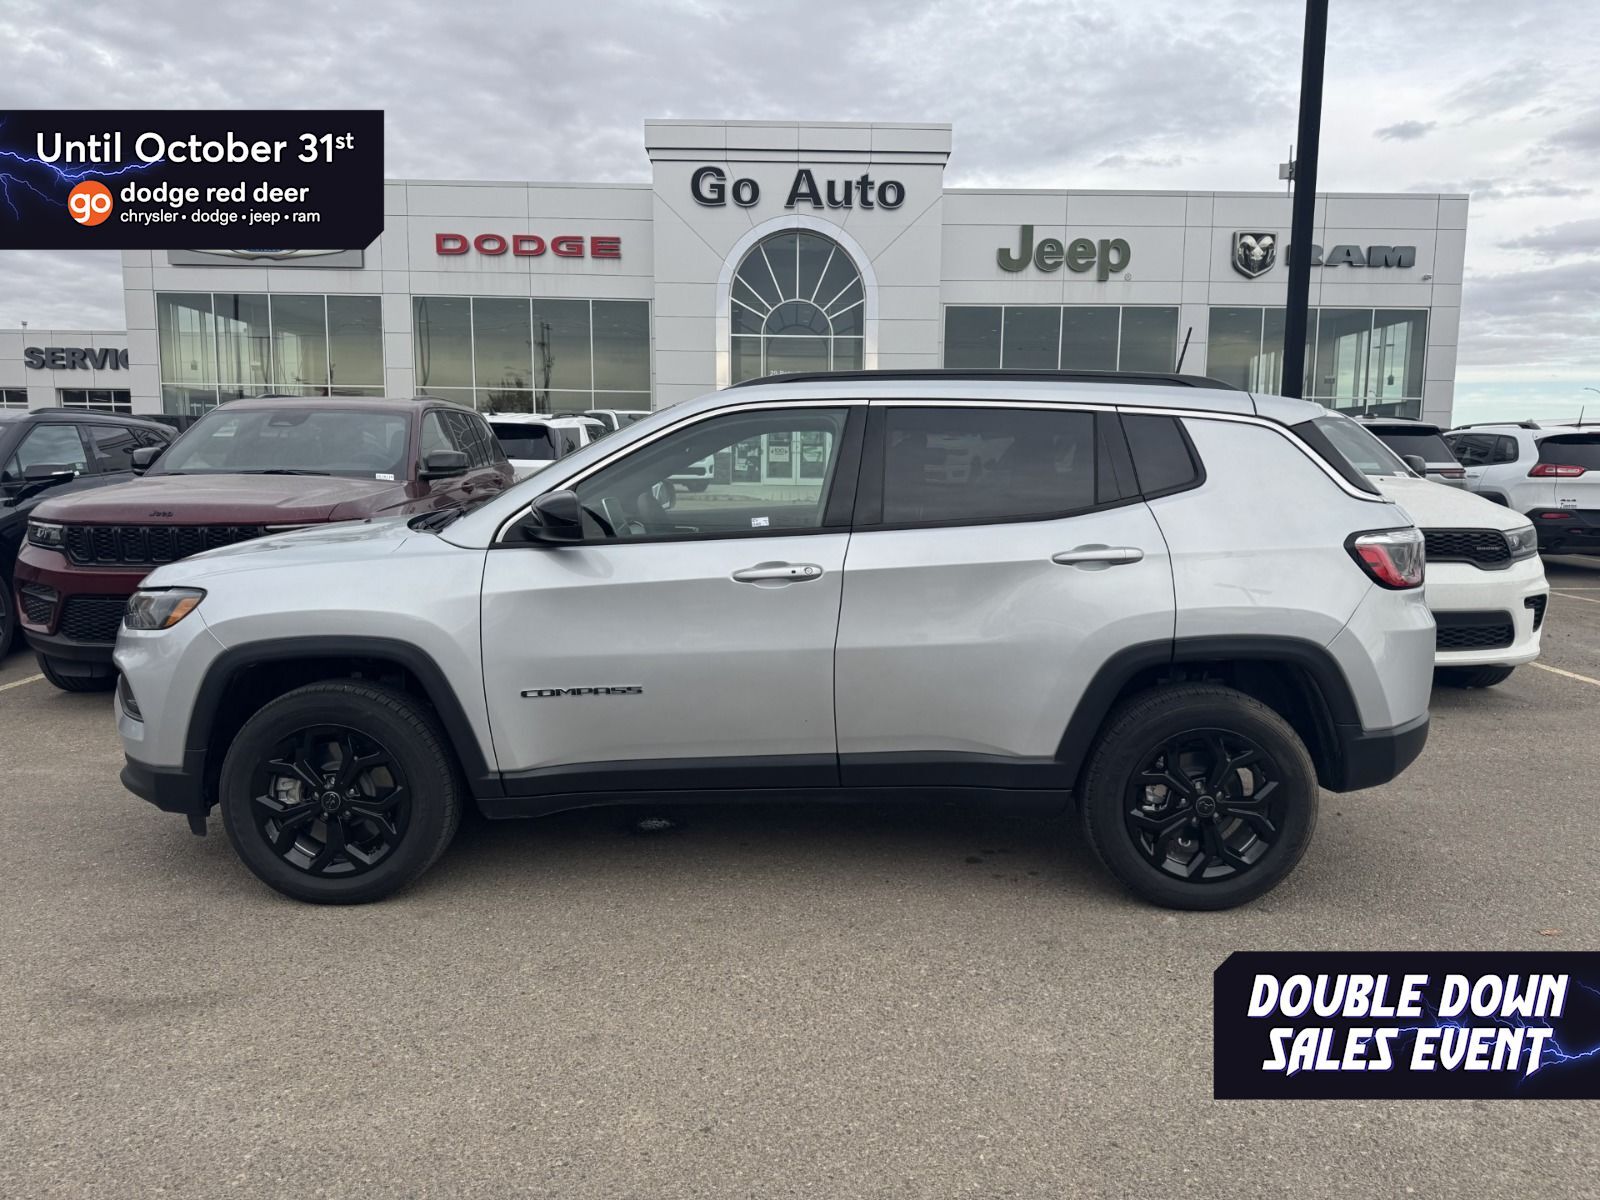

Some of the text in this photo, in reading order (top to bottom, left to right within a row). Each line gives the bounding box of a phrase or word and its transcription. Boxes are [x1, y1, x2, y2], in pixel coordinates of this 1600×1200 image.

[690, 165, 907, 210] Go Auto
[435, 233, 621, 259] DODGE
[996, 224, 1132, 282] Jeep
[520, 686, 644, 699] COMPASS
